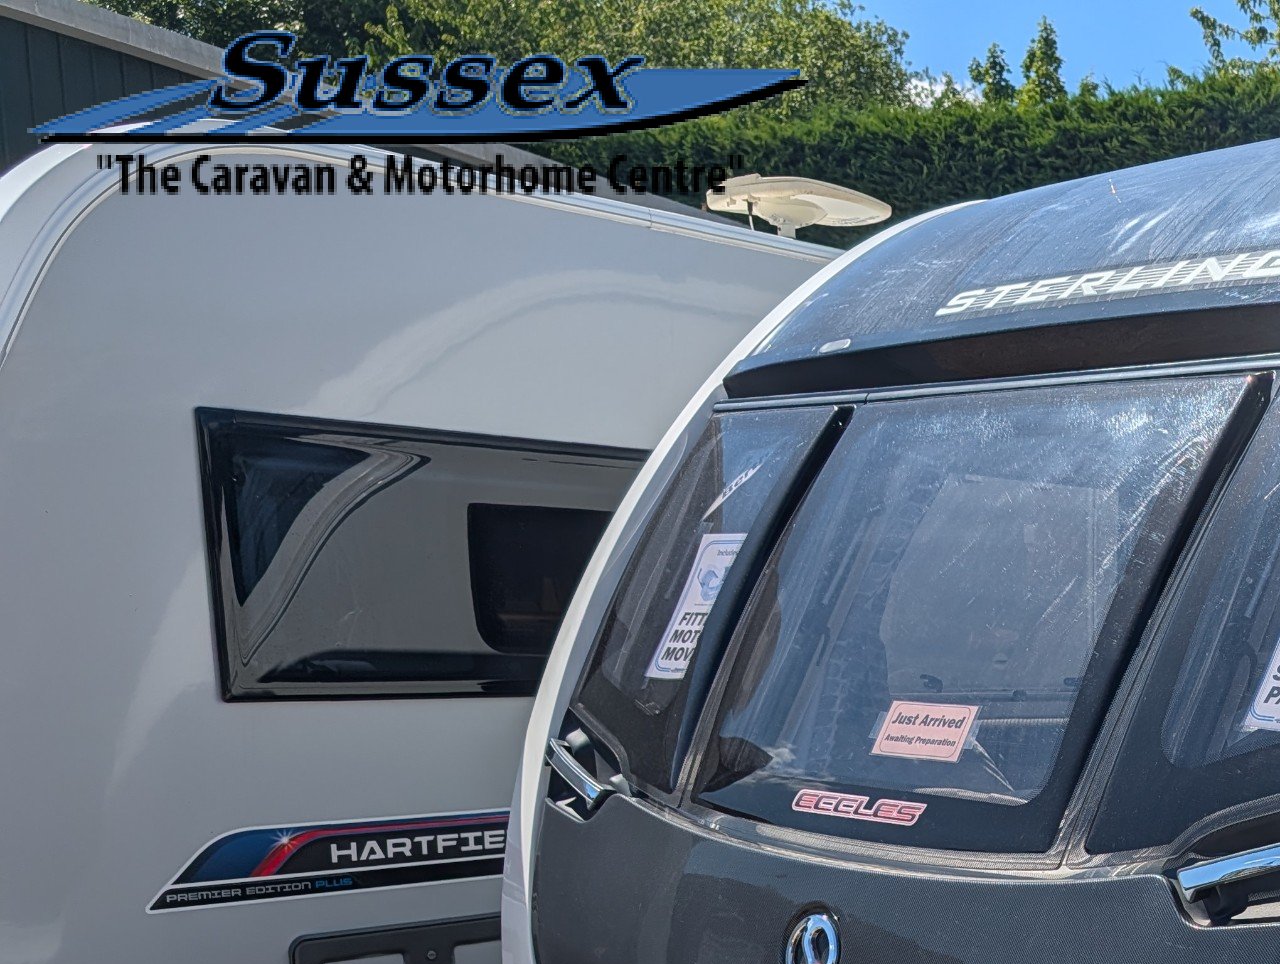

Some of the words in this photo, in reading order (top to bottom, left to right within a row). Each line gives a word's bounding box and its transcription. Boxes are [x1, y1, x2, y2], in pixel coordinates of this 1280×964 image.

[892, 711, 920, 726] Just
[919, 714, 967, 729] Arrived
[884, 733, 916, 745] Awaiting
[914, 736, 957, 747] Preparation
[793, 791, 926, 825] ECCLES
[166, 888, 242, 903] PREMIER
[245, 881, 312, 896] EDITION
[315, 877, 353, 889] PLUS
